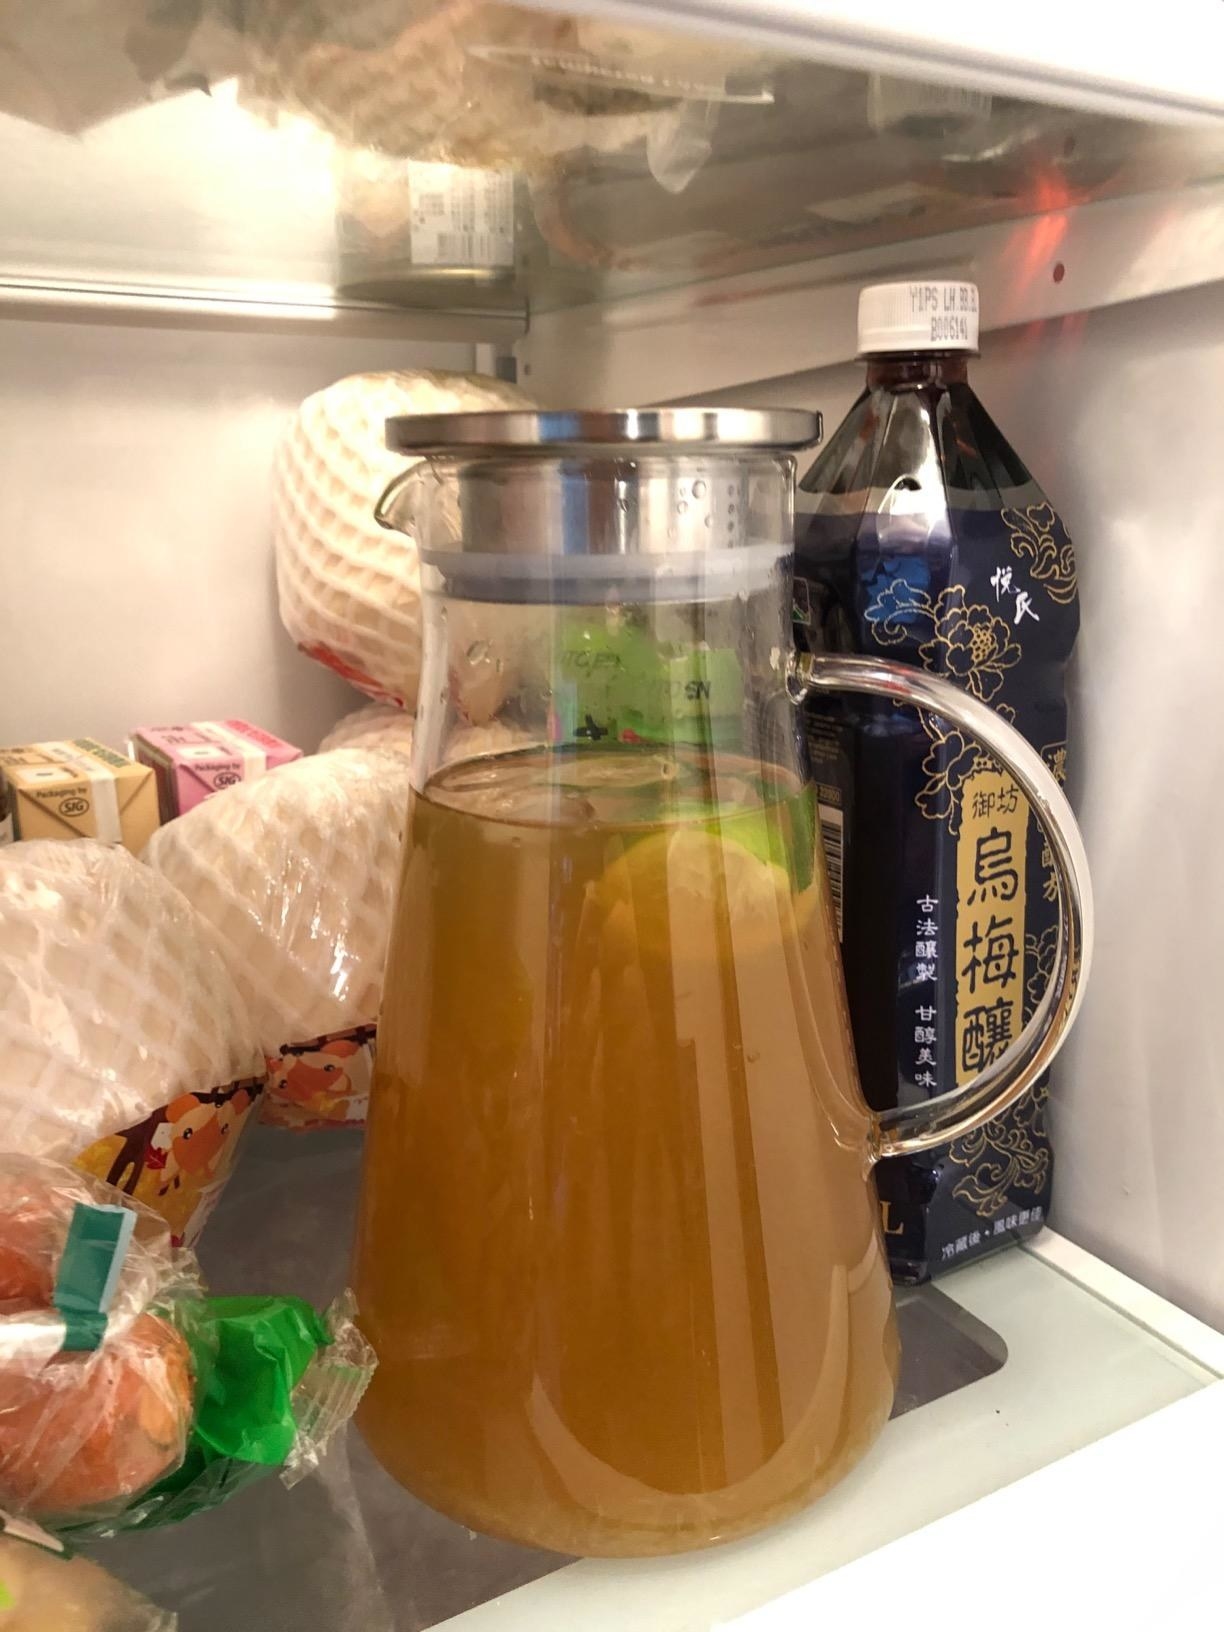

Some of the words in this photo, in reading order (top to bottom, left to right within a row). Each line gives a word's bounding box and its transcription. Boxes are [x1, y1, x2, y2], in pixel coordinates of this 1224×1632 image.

[63, 800, 85, 814] SIG
[972, 784, 1019, 819] 御坊
[915, 894, 939, 981] 古法釀製
[914, 1005, 938, 1088] 甘醇美味
